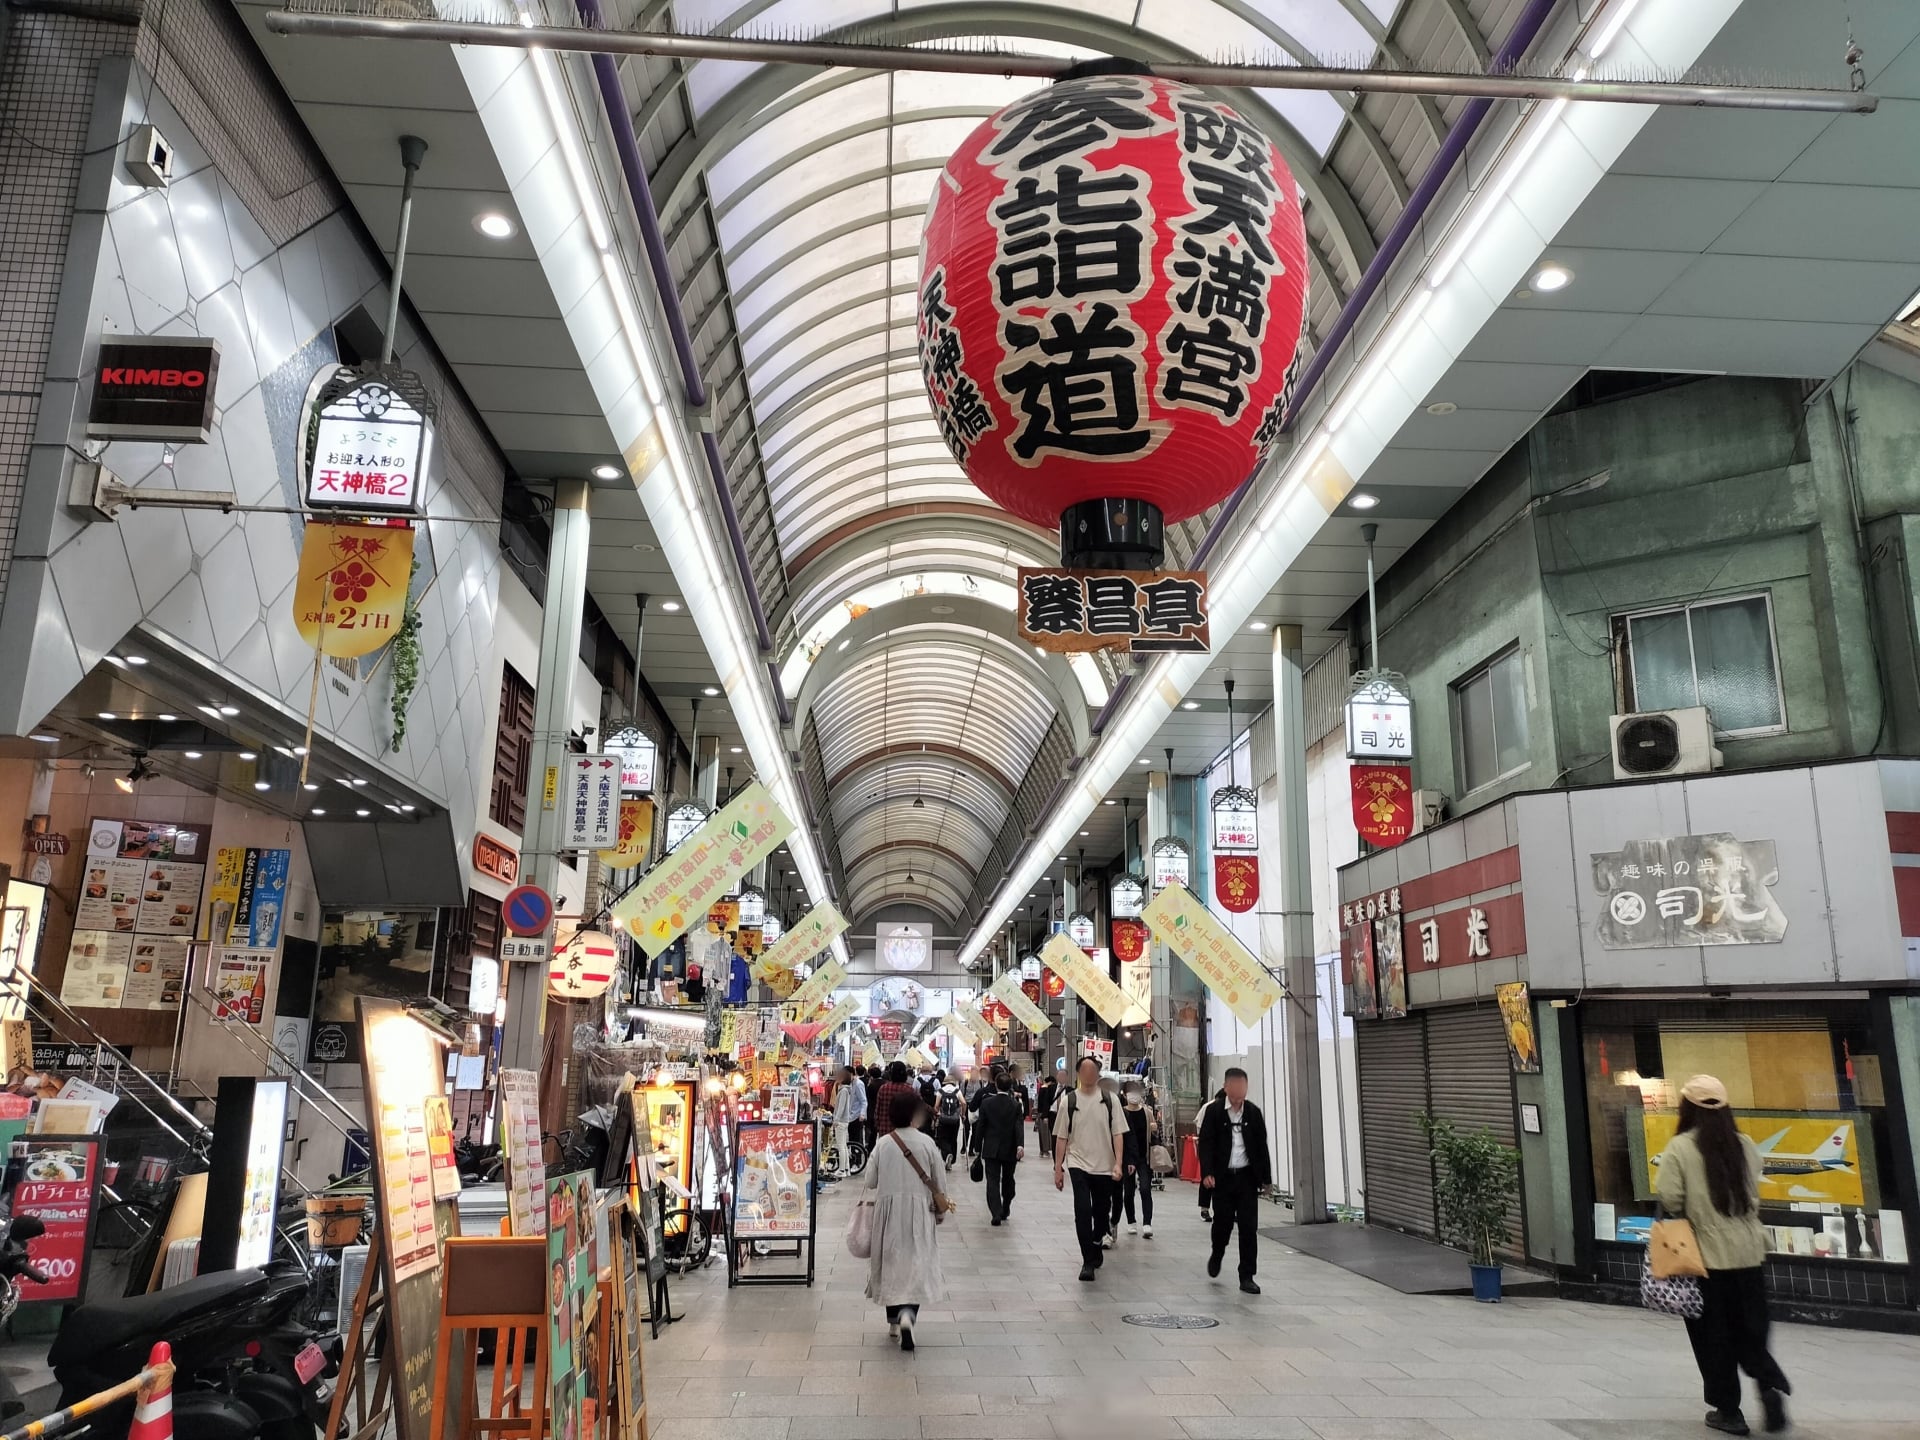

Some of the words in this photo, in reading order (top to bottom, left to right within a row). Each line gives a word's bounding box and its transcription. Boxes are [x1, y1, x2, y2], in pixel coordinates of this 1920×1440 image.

[1164, 93, 1276, 417] 阪天満宮
[101, 367, 205, 387] KIMBO
[339, 429, 400, 447] ようこそ
[326, 451, 406, 468] お迎え人形の
[316, 469, 409, 497] 天神橋2
[1023, 575, 1206, 634] 繁昌亭
[573, 774, 590, 833] 天満天神繁昌亭
[596, 774, 611, 833] 大阪天満宮北門
[34, 838, 64, 854] OPEN
[573, 834, 587, 843] 50m
[594, 834, 608, 843] 50m
[1620, 855, 1747, 879] 趣味の呉服
[1655, 878, 1769, 926] 司光
[502, 942, 546, 958] 自動車
[767, 1124, 813, 1140] ジムビーム
